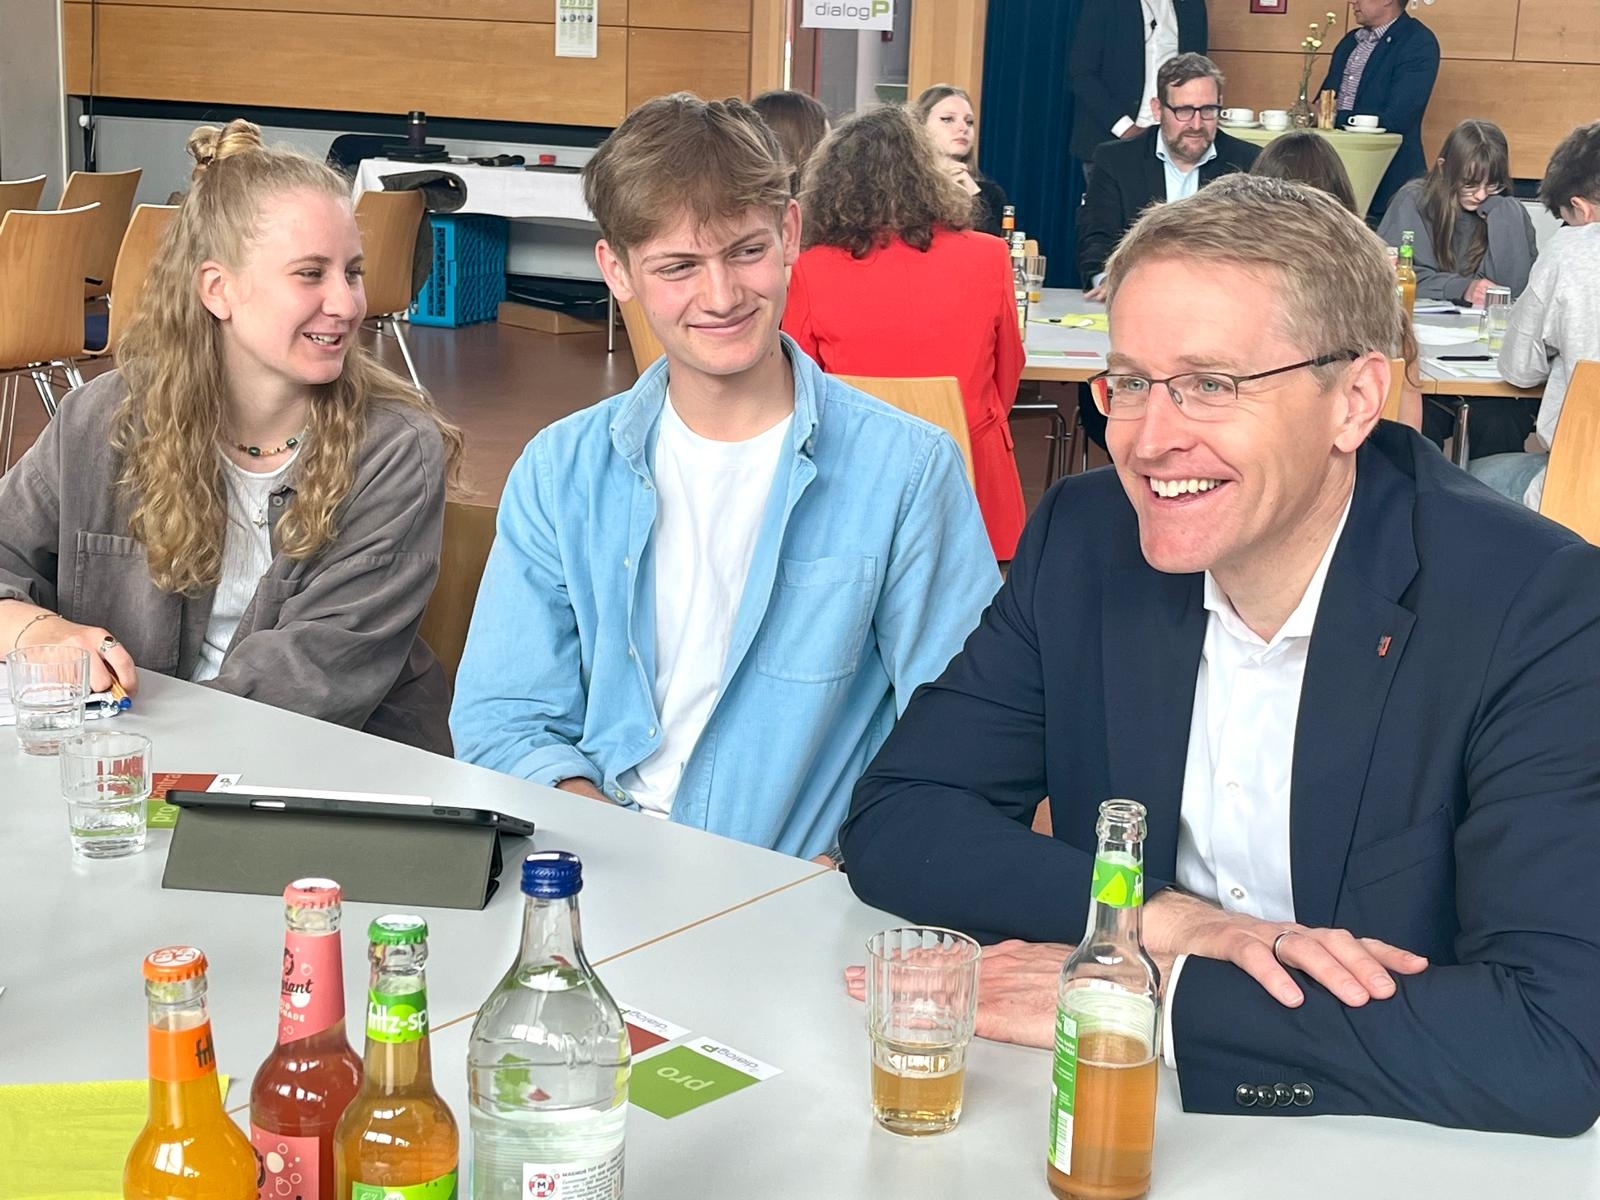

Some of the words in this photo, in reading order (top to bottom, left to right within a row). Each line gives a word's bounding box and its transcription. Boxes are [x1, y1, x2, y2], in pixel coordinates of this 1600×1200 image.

[815, 1, 890, 20] dialogP
[151, 805, 178, 823] pro
[700, 1044, 759, 1069] dialogP
[656, 1067, 715, 1092] pro
